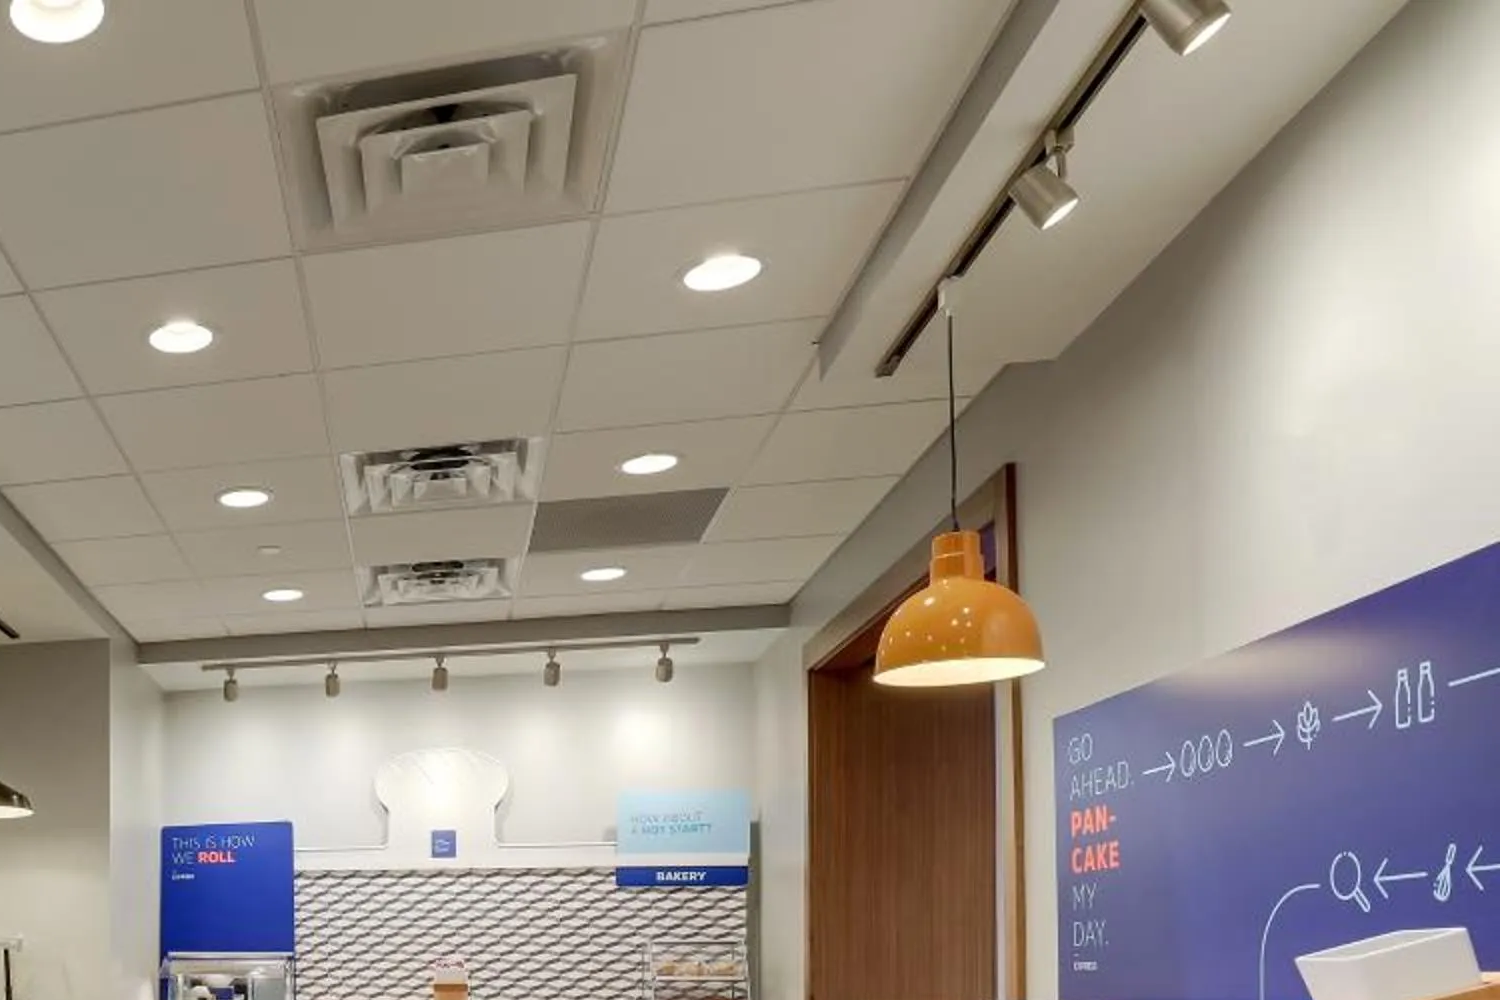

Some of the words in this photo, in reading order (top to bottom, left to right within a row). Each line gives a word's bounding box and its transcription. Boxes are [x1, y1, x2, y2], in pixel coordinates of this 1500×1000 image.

[1068, 733, 1093, 765] GO
[1069, 761, 1134, 801] AHEAD.
[1071, 804, 1116, 838] PAN-
[172, 837, 201, 850] THIS
[205, 835, 218, 849] IS
[222, 834, 256, 849] HOW
[172, 851, 195, 865] WE
[198, 850, 236, 863] ROLL
[1071, 840, 1120, 875] CAKE
[656, 871, 707, 881] BAKERY
[1072, 882, 1098, 911] MY
[1073, 918, 1109, 950] DAY.
